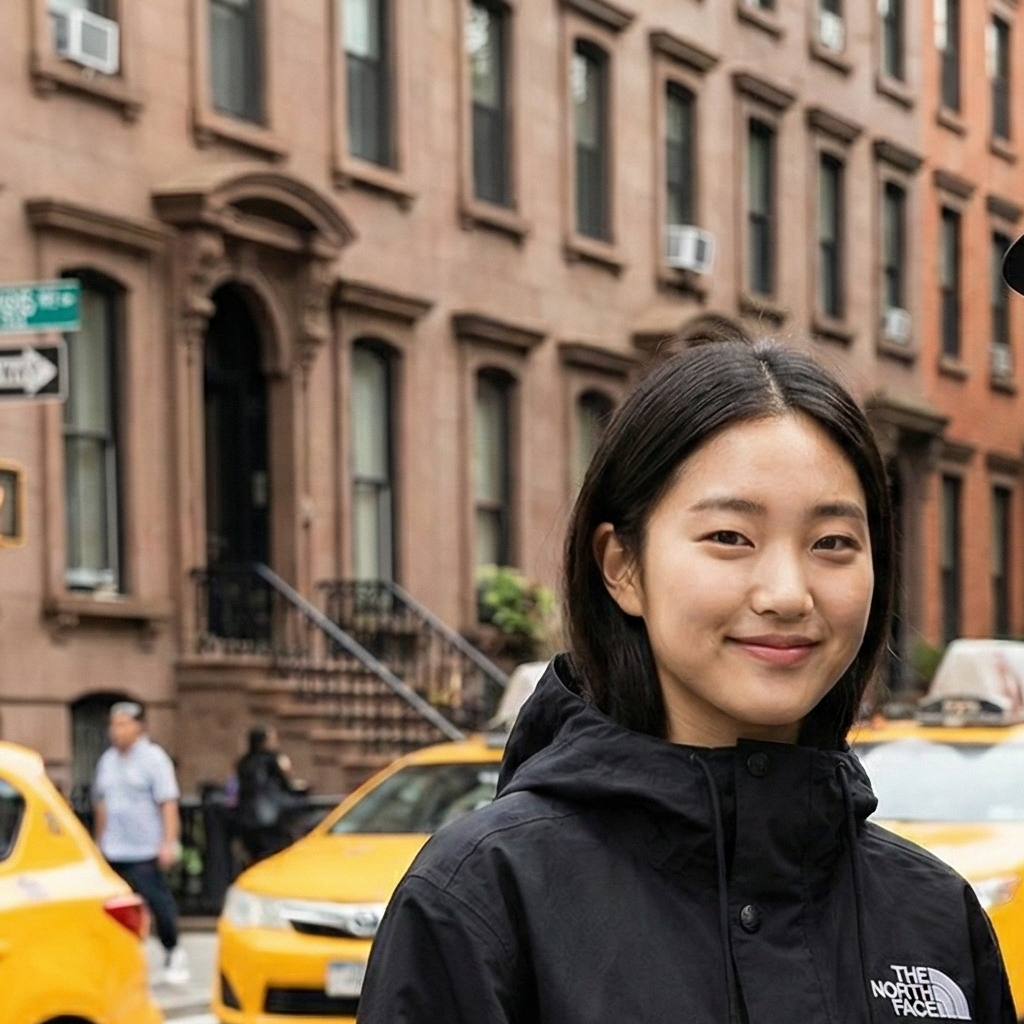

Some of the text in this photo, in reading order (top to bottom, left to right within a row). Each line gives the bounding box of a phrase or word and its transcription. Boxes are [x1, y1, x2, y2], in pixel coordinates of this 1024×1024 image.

[890, 965, 930, 984] THE
[870, 979, 935, 1001] NORTH
[891, 998, 940, 1018] FACE
